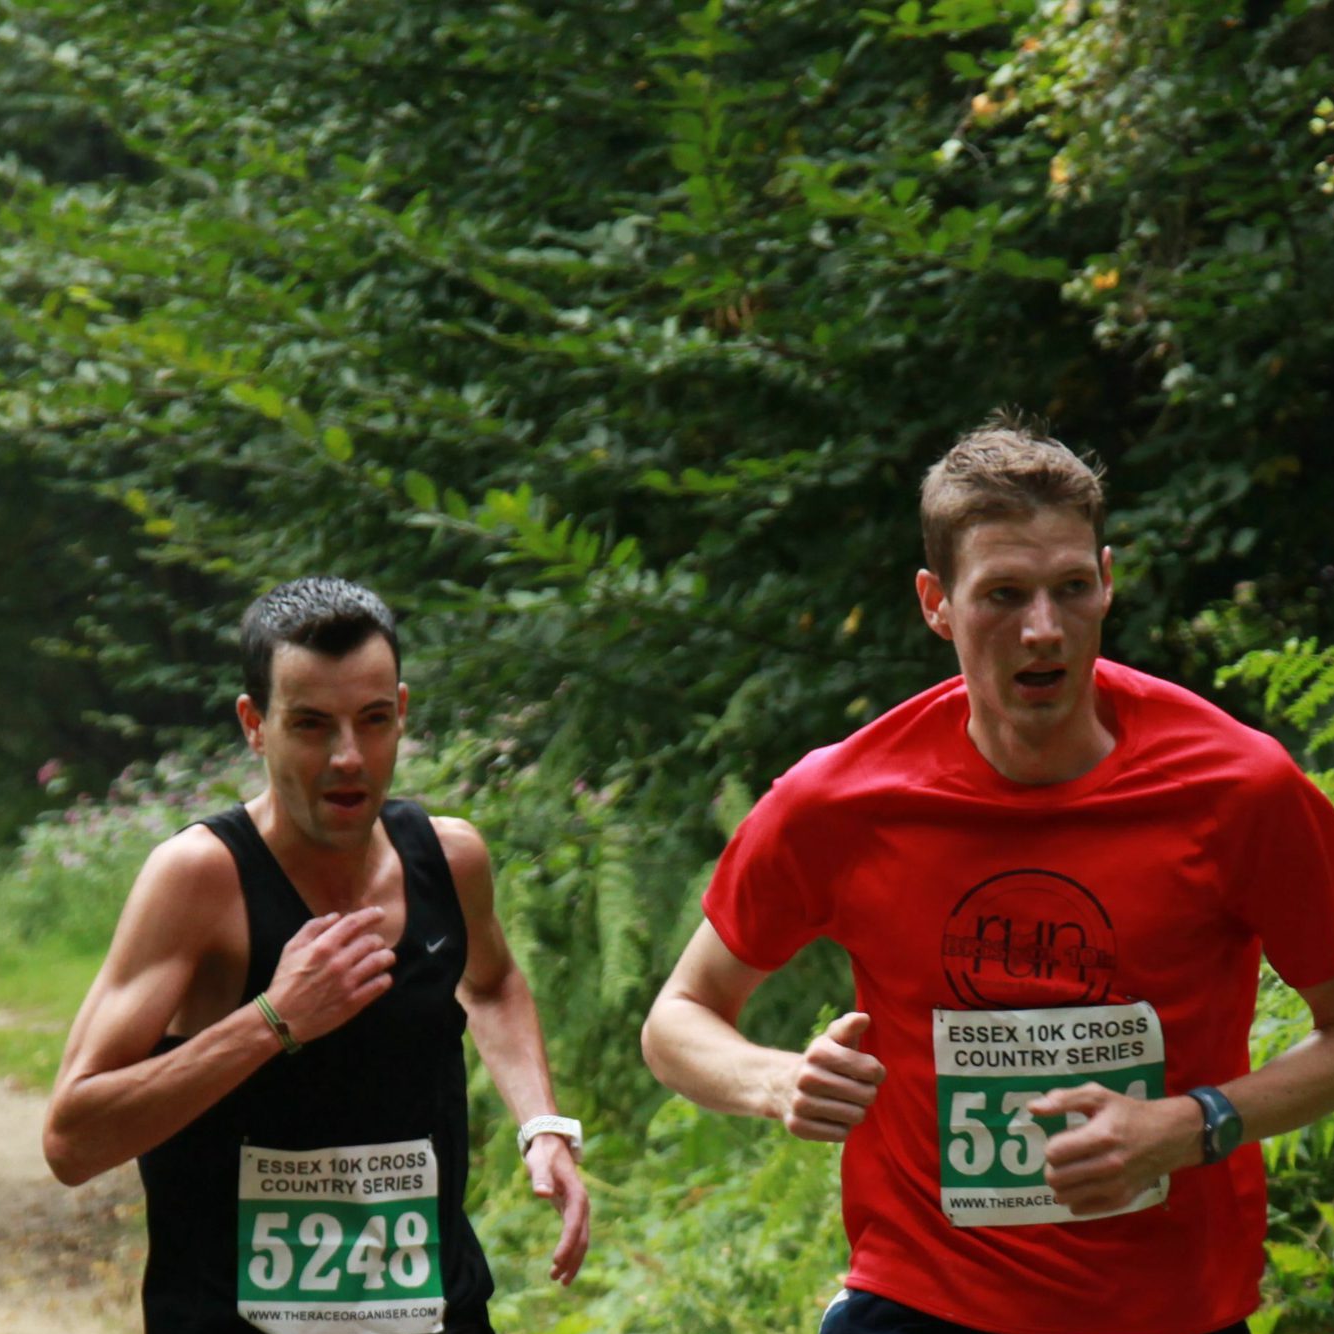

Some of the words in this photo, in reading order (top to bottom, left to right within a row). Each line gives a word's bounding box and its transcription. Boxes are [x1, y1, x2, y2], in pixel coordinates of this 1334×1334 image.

[948, 1026, 1019, 1043] ESSEX
[1026, 1024, 1065, 1042] 10K
[1072, 1017, 1149, 1040] CROSS
[954, 1049, 1060, 1067] COUNTRY
[1067, 1041, 1145, 1065] SERIES
[948, 1080, 1147, 1176] 53
[257, 1159, 322, 1175] ESSEX
[329, 1157, 363, 1174] 10K
[367, 1151, 427, 1172] CROSS
[261, 1178, 358, 1194] COUNTRY
[362, 1174, 423, 1195] SERIES
[247, 1211, 431, 1291] 5248
[247, 1307, 438, 1322] WWW.THERACEORGANISER.COM
